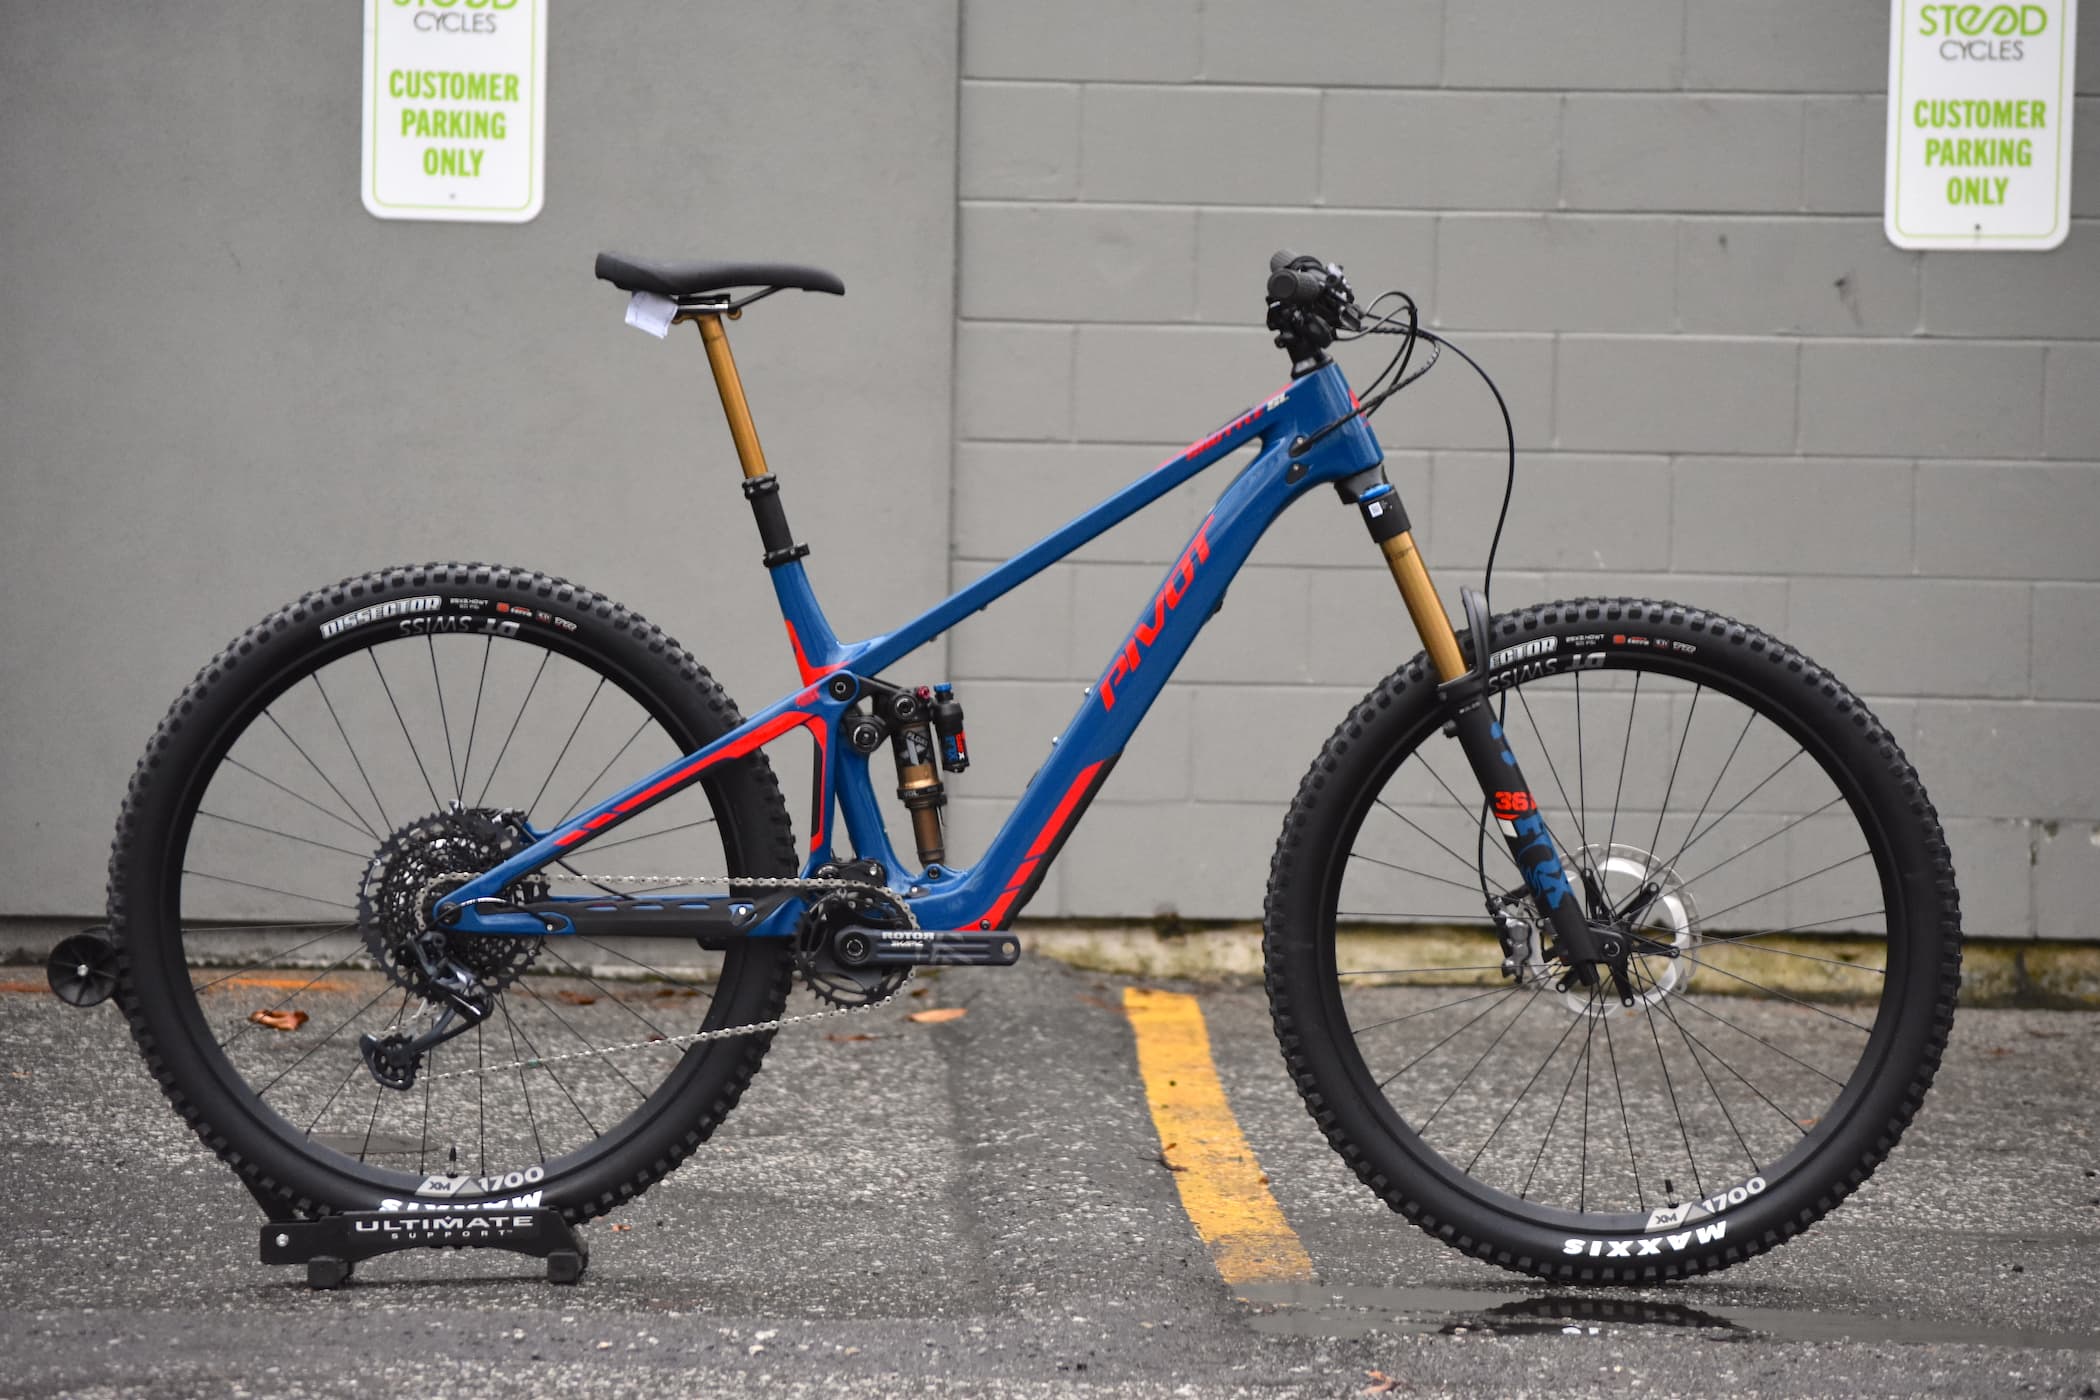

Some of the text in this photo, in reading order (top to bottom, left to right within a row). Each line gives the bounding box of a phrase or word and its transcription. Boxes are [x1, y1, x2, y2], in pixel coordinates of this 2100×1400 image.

[414, 11, 496, 34] CYCLES
[1939, 39, 2023, 61] CYCLES
[389, 69, 519, 102] CUSTOMER
[401, 108, 507, 140] PARKING
[1913, 99, 2046, 129] CUSTOMER
[422, 147, 485, 177] ONLY
[1925, 138, 2033, 167] PARKING
[1946, 177, 2009, 206] ONLY
[320, 595, 442, 640] DISSECTOR
[400, 616, 472, 636] SWISS
[479, 617, 520, 638] DT
[1099, 514, 1215, 712] PIVOT
[1490, 636, 1558, 670] ECTOR
[1489, 652, 1605, 688] DT SWISS
[429, 1166, 544, 1192] XM 1700
[1655, 1176, 1767, 1225] XM 1700
[354, 1216, 534, 1232] ULTIMATE
[1563, 1220, 1727, 1257] MAXXIS
